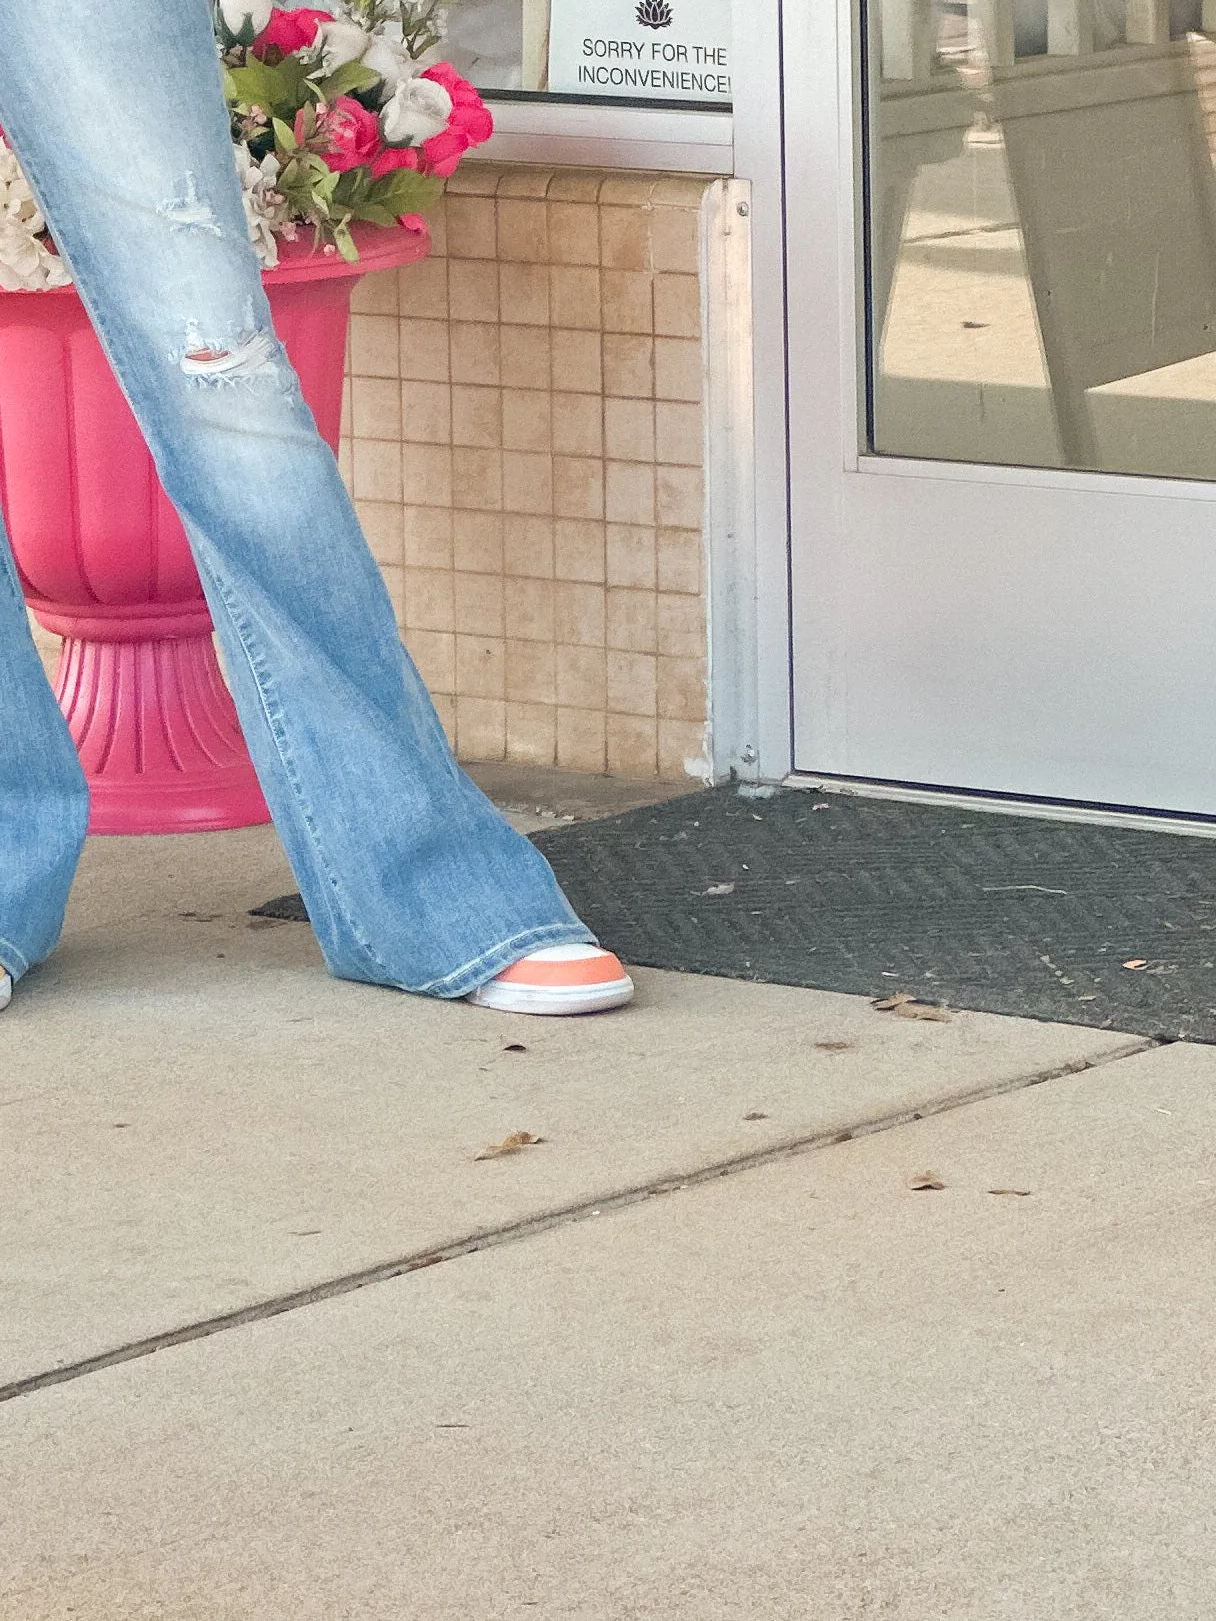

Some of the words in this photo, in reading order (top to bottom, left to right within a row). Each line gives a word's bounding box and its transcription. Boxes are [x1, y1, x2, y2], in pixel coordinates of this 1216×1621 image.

[582, 38, 645, 60] SORRY
[651, 43, 688, 64] FOR
[692, 46, 728, 66] THE
